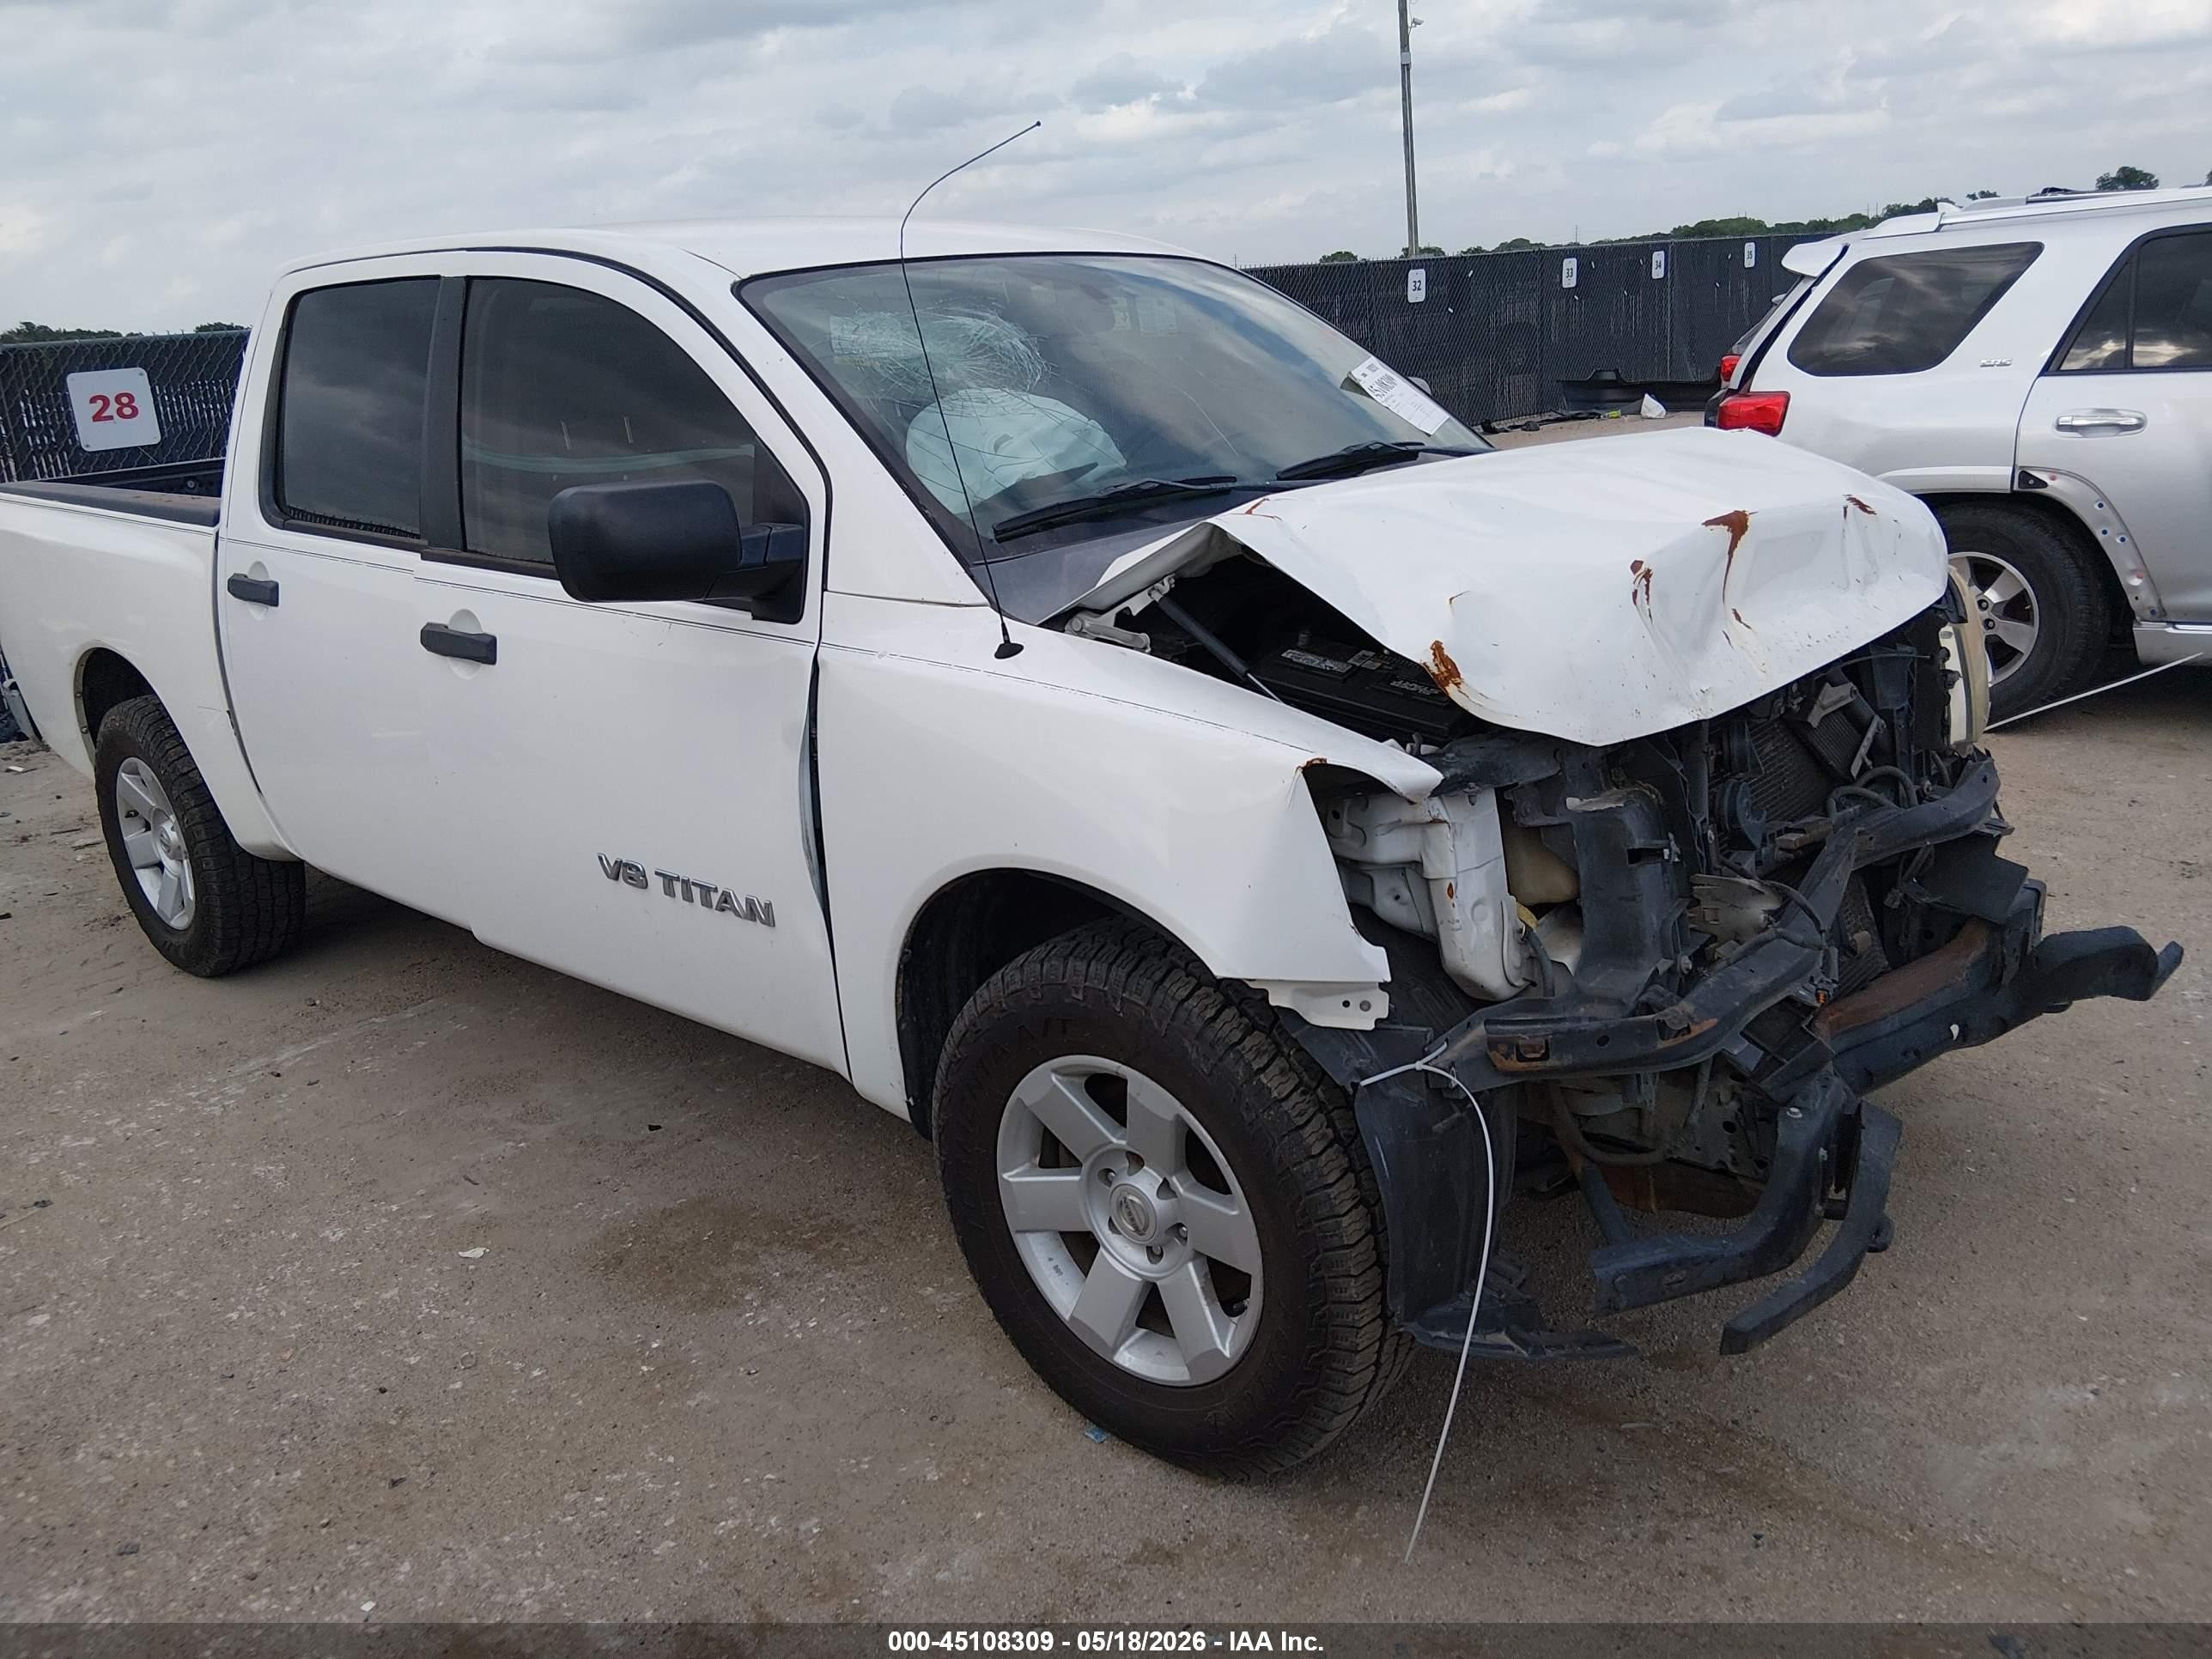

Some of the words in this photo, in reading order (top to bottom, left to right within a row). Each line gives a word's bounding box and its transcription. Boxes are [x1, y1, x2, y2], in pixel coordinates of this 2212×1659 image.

[1747, 250, 1753, 260] 35
[1655, 259, 1662, 270] 34
[1565, 267, 1574, 278] 33
[1412, 279, 1422, 292] 32
[89, 392, 139, 422] 28
[597, 851, 648, 890] V8
[653, 867, 776, 928] TITAN
